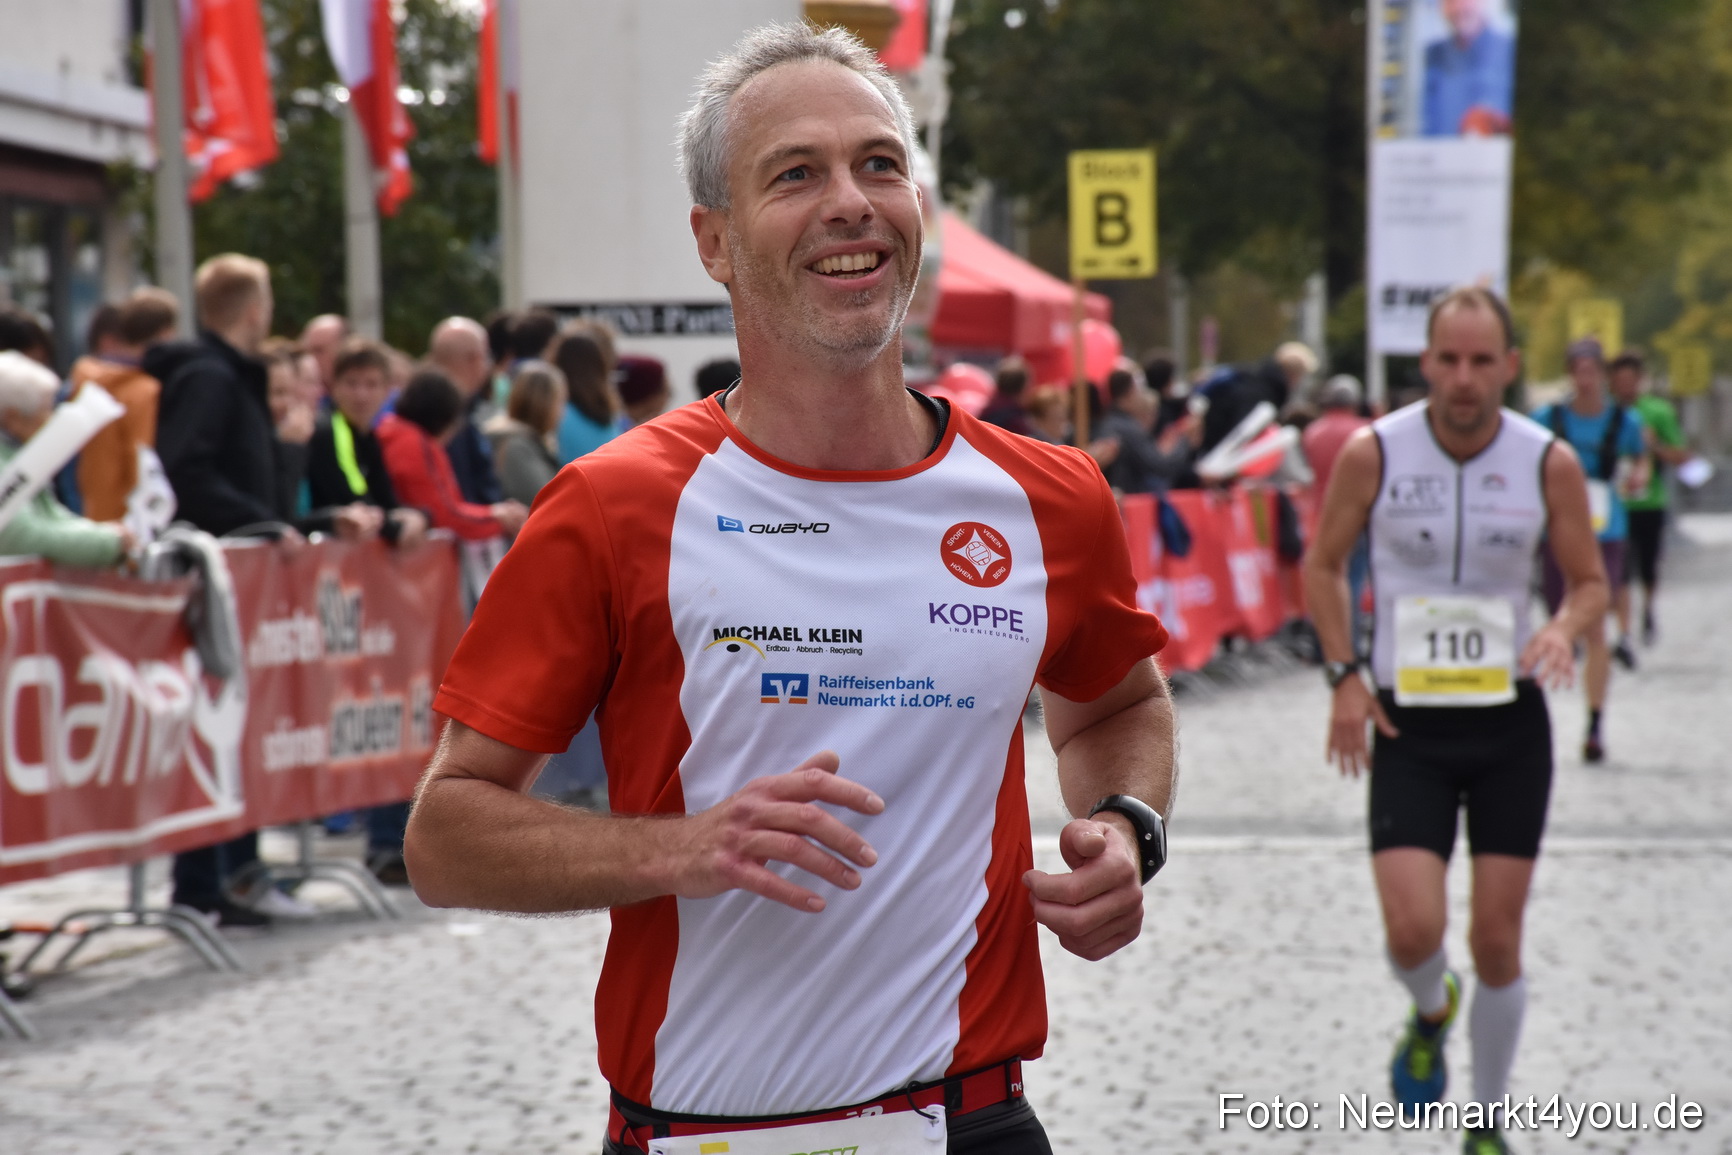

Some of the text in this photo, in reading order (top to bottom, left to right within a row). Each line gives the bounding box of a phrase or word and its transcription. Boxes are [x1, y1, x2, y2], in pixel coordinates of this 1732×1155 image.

[1094, 191, 1132, 248] B
[982, 528, 1003, 549] VEREIN
[992, 566, 1007, 580] BERG
[928, 602, 1024, 634] KOPPE
[713, 625, 863, 643] MICHAEL KLEIN
[949, 627, 1030, 643] INGENIEURBÜRO
[765, 644, 863, 656] Erdbau Abbruch Recycling
[1424, 629, 1484, 662] 110
[819, 674, 935, 690] Raiffeisenbank
[817, 692, 975, 709] Neumarkt i.d.OPf. eG
